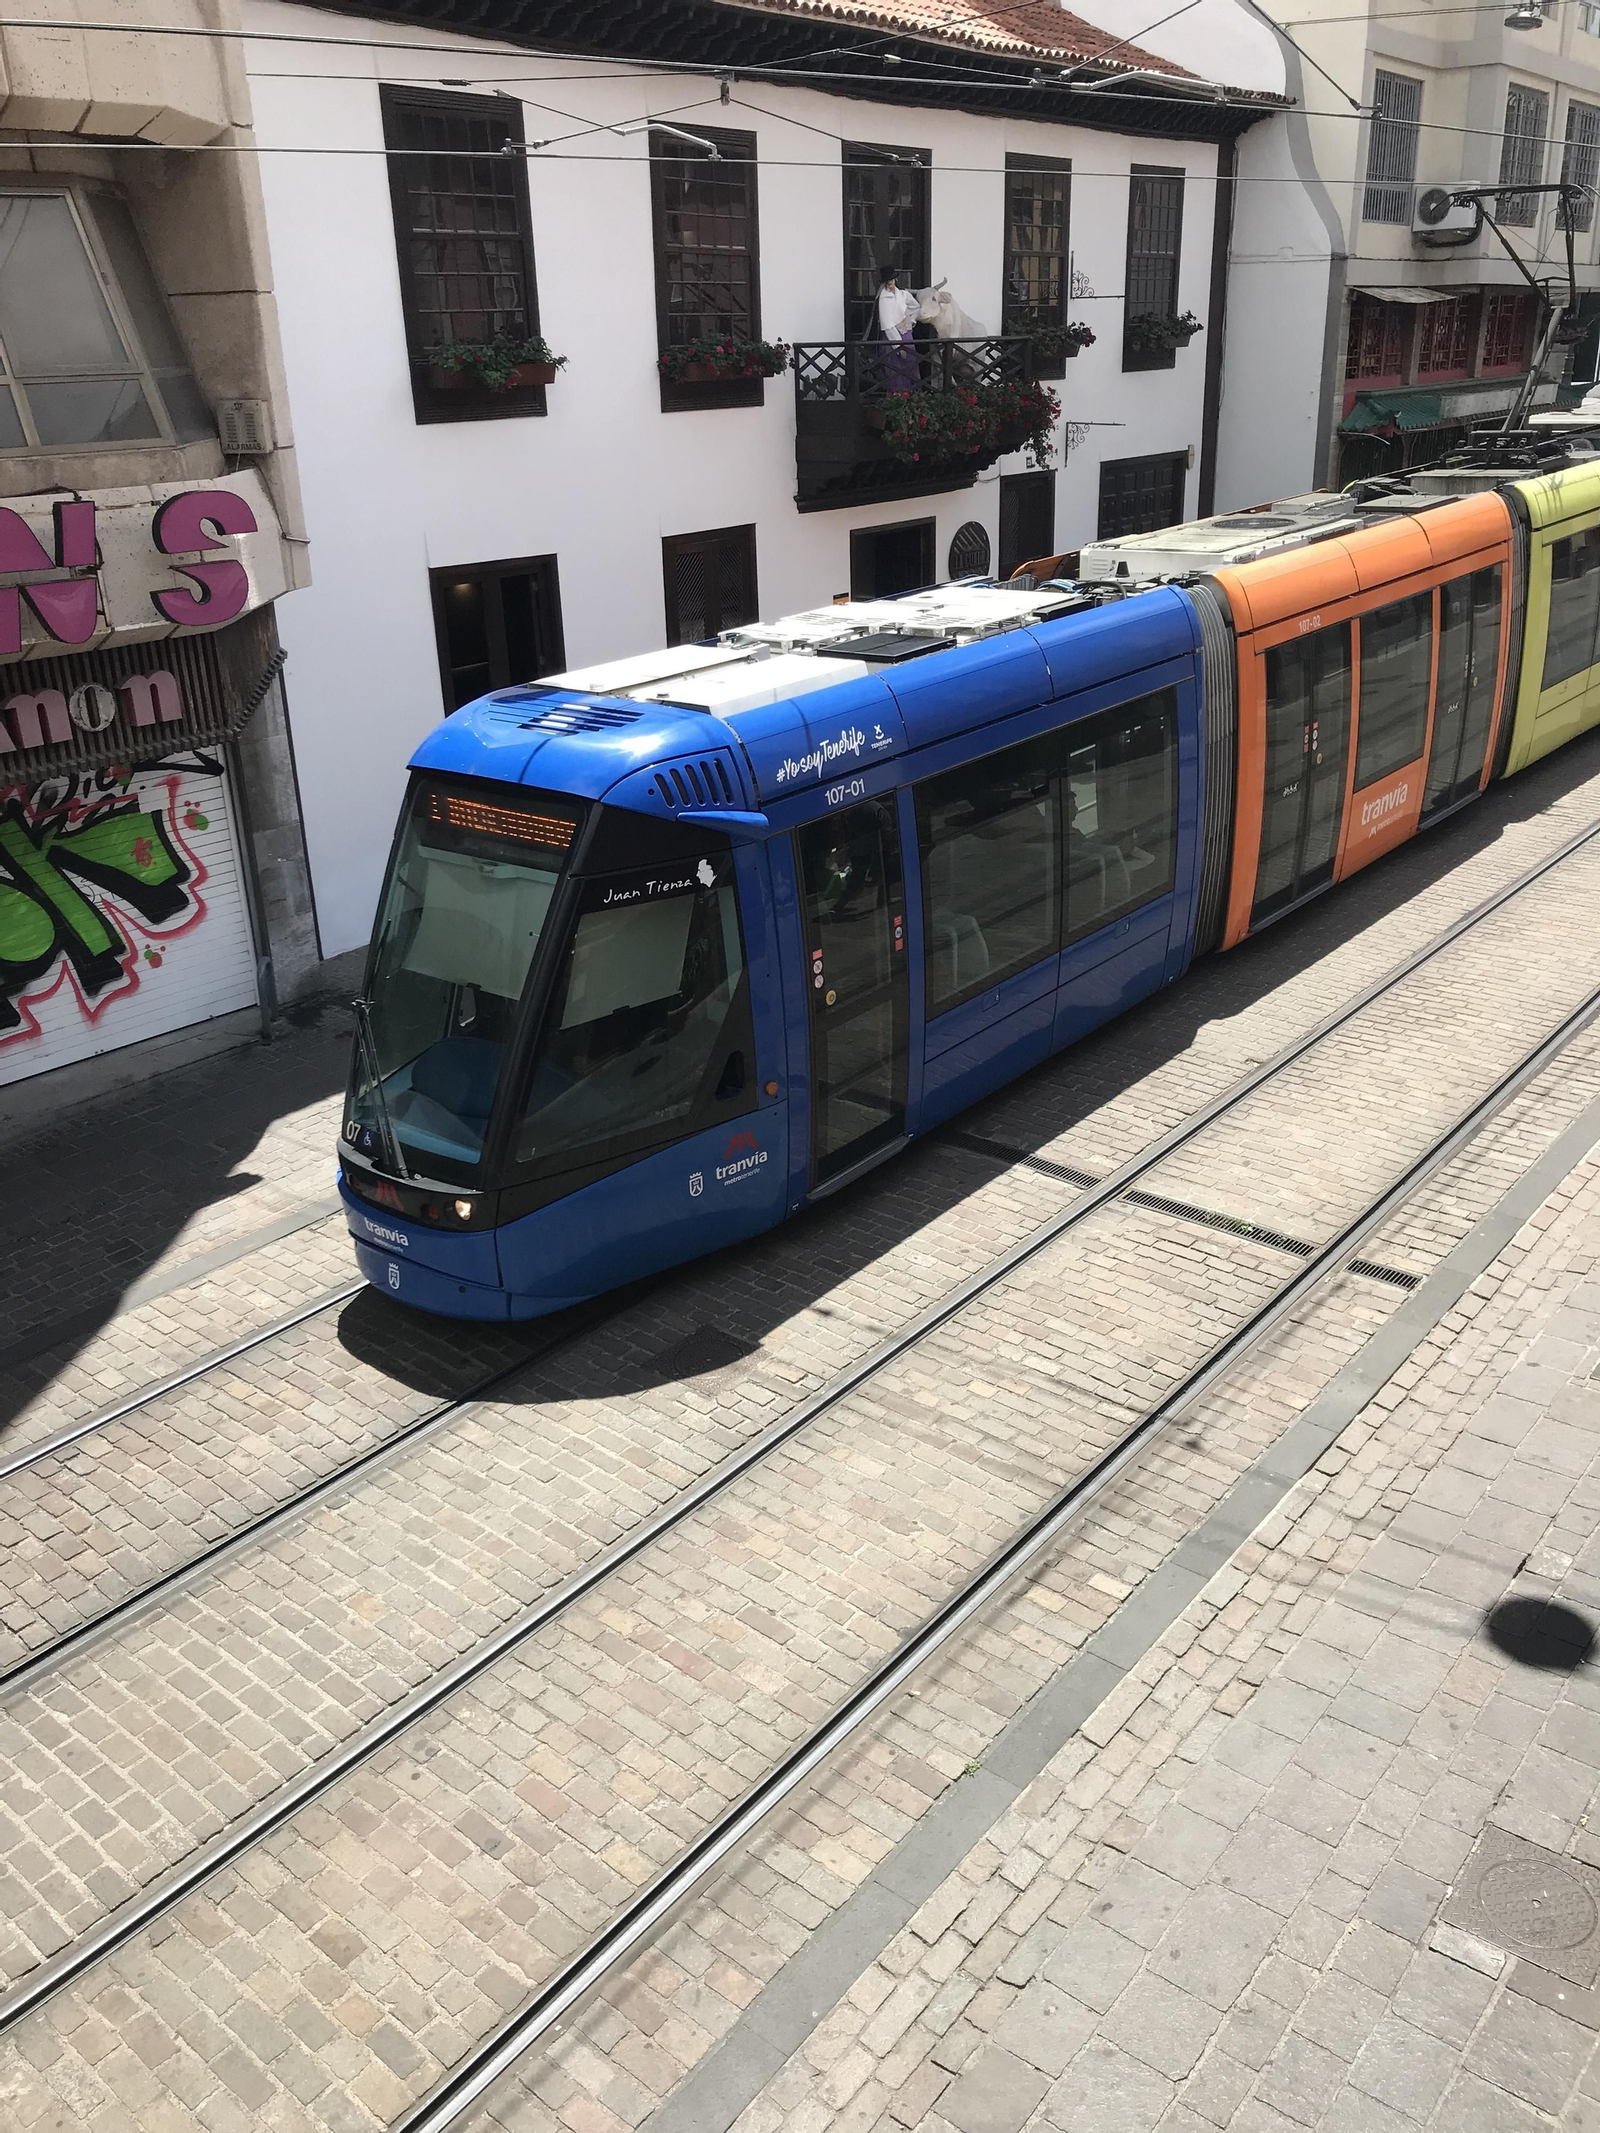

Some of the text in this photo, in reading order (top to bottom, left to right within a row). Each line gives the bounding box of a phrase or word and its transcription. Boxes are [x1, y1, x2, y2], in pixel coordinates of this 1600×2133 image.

[226, 443, 262, 451] ALARMAS
[1298, 615, 1321, 633] 107-02
[825, 778, 865, 806] 107-01
[603, 879, 693, 904] Juan Tienza
[346, 1120, 361, 1142] 07
